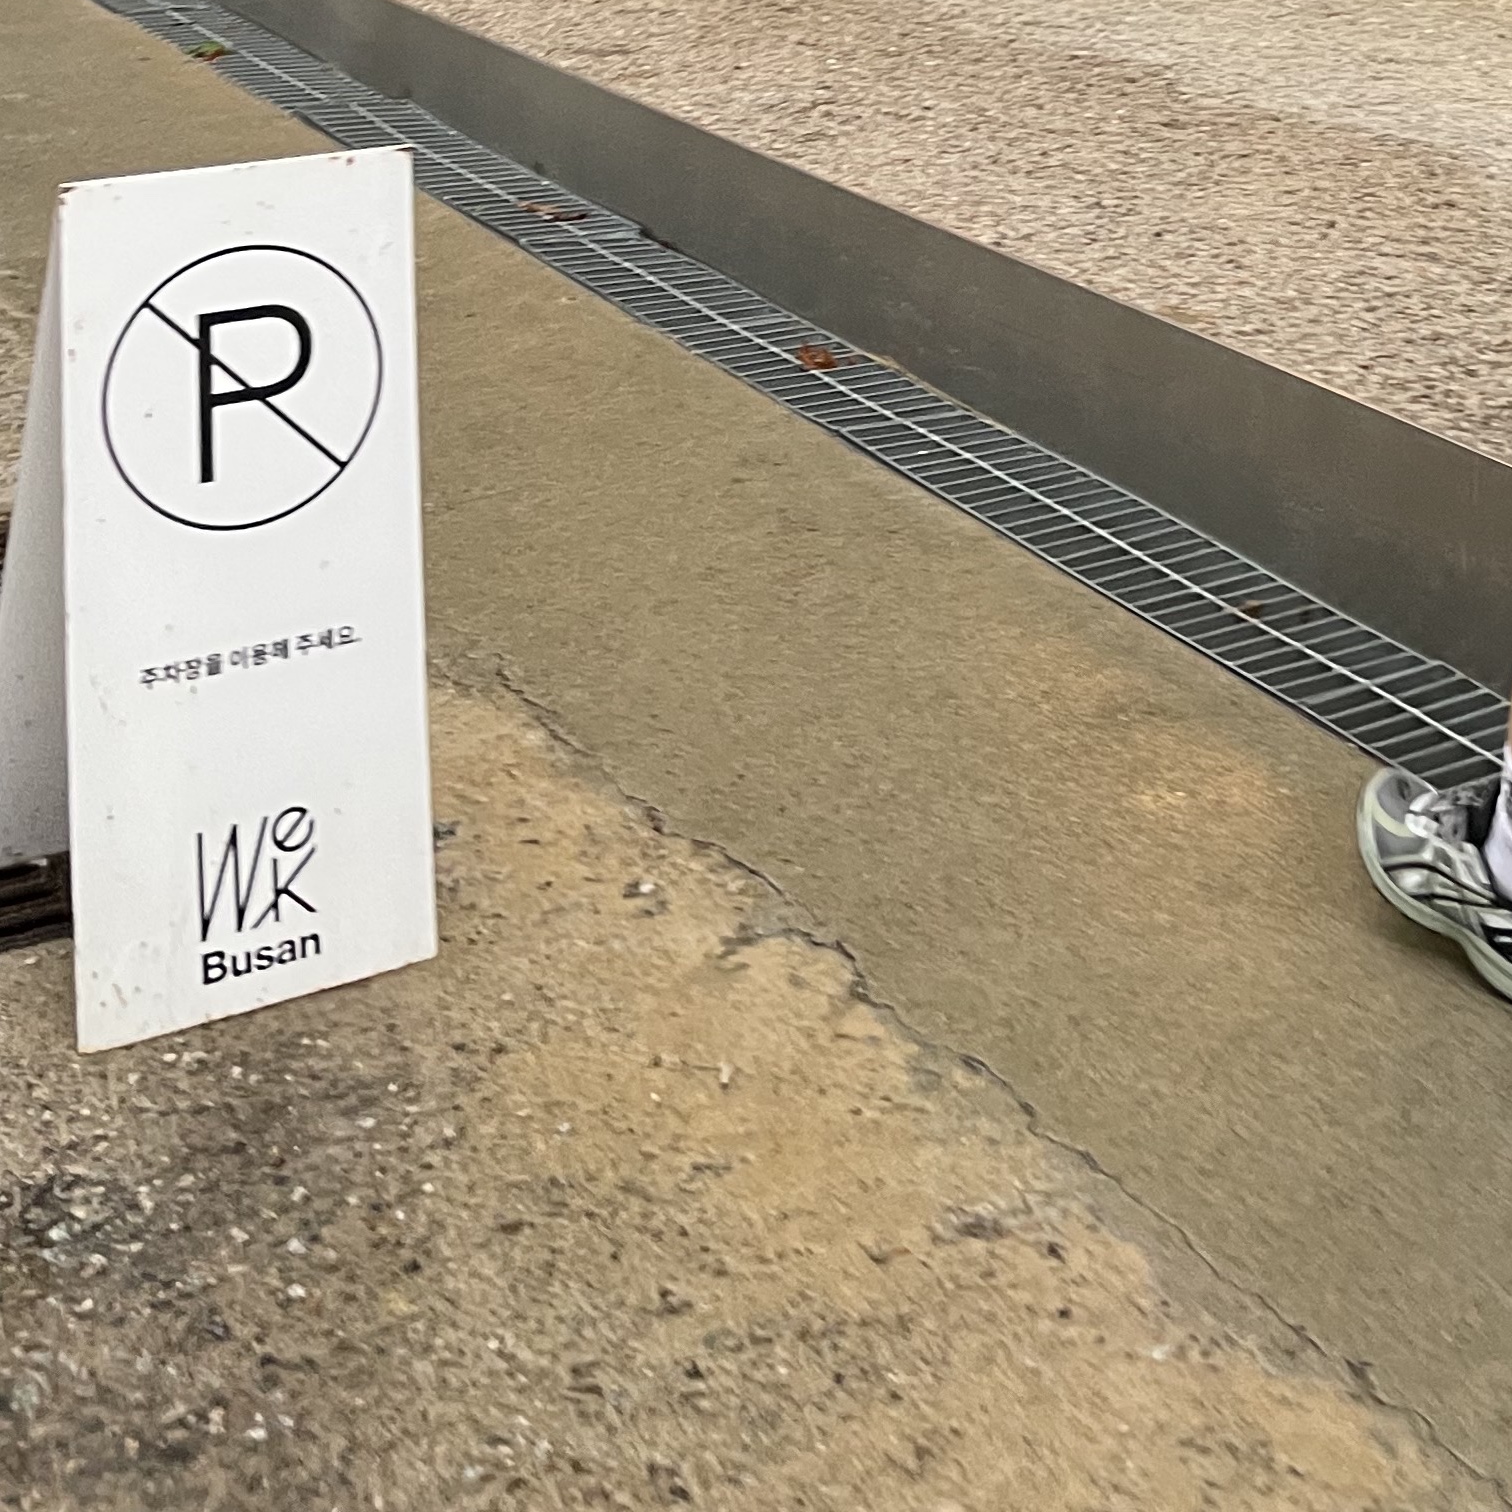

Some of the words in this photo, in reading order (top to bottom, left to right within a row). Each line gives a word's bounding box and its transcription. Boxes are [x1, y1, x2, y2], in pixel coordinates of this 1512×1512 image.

[140, 653, 222, 689] 주차장을
[230, 639, 289, 669] 이용해
[202, 933, 320, 985] Busan
